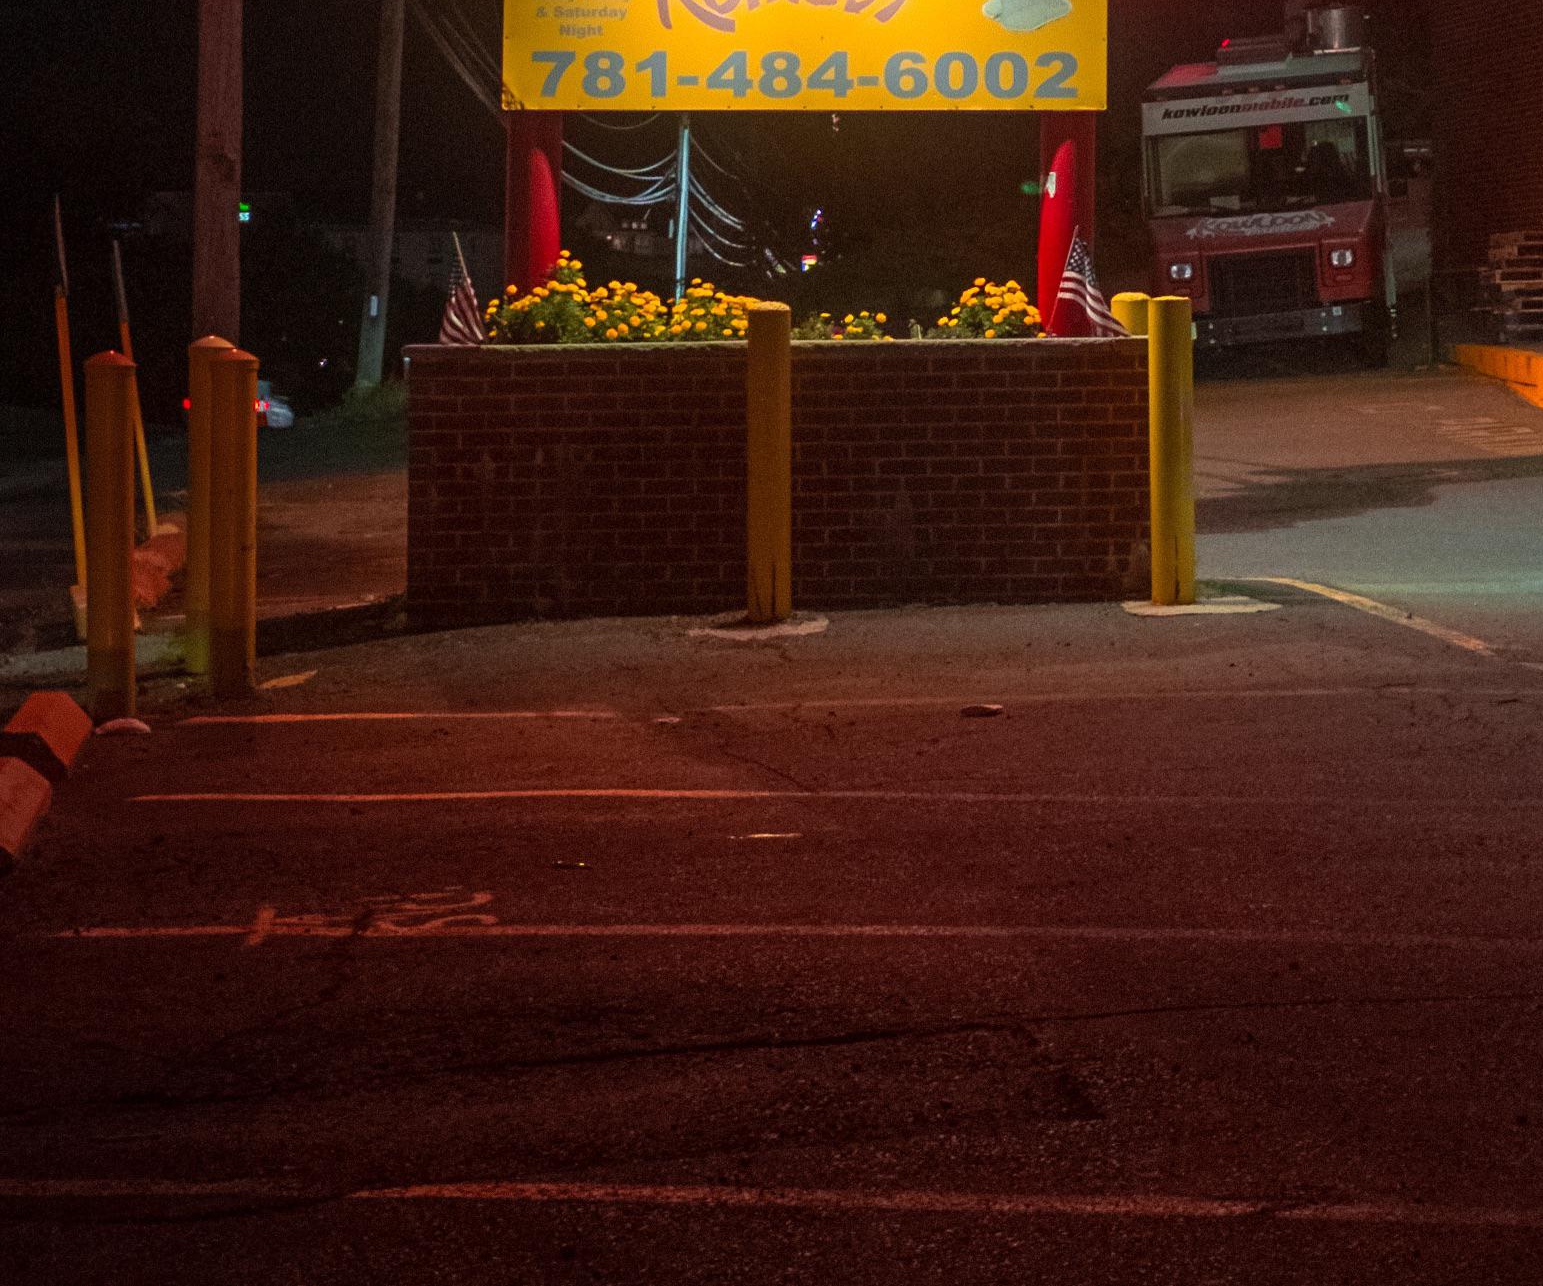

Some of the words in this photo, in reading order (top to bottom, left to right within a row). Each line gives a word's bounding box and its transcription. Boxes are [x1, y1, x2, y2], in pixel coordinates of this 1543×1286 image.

[536, 6, 548, 18] &
[554, 6, 628, 21] Saturday
[559, 24, 604, 38] Night
[531, 49, 1079, 99] 781-484-6002
[1162, 93, 1350, 120] kowloonmobile.com
